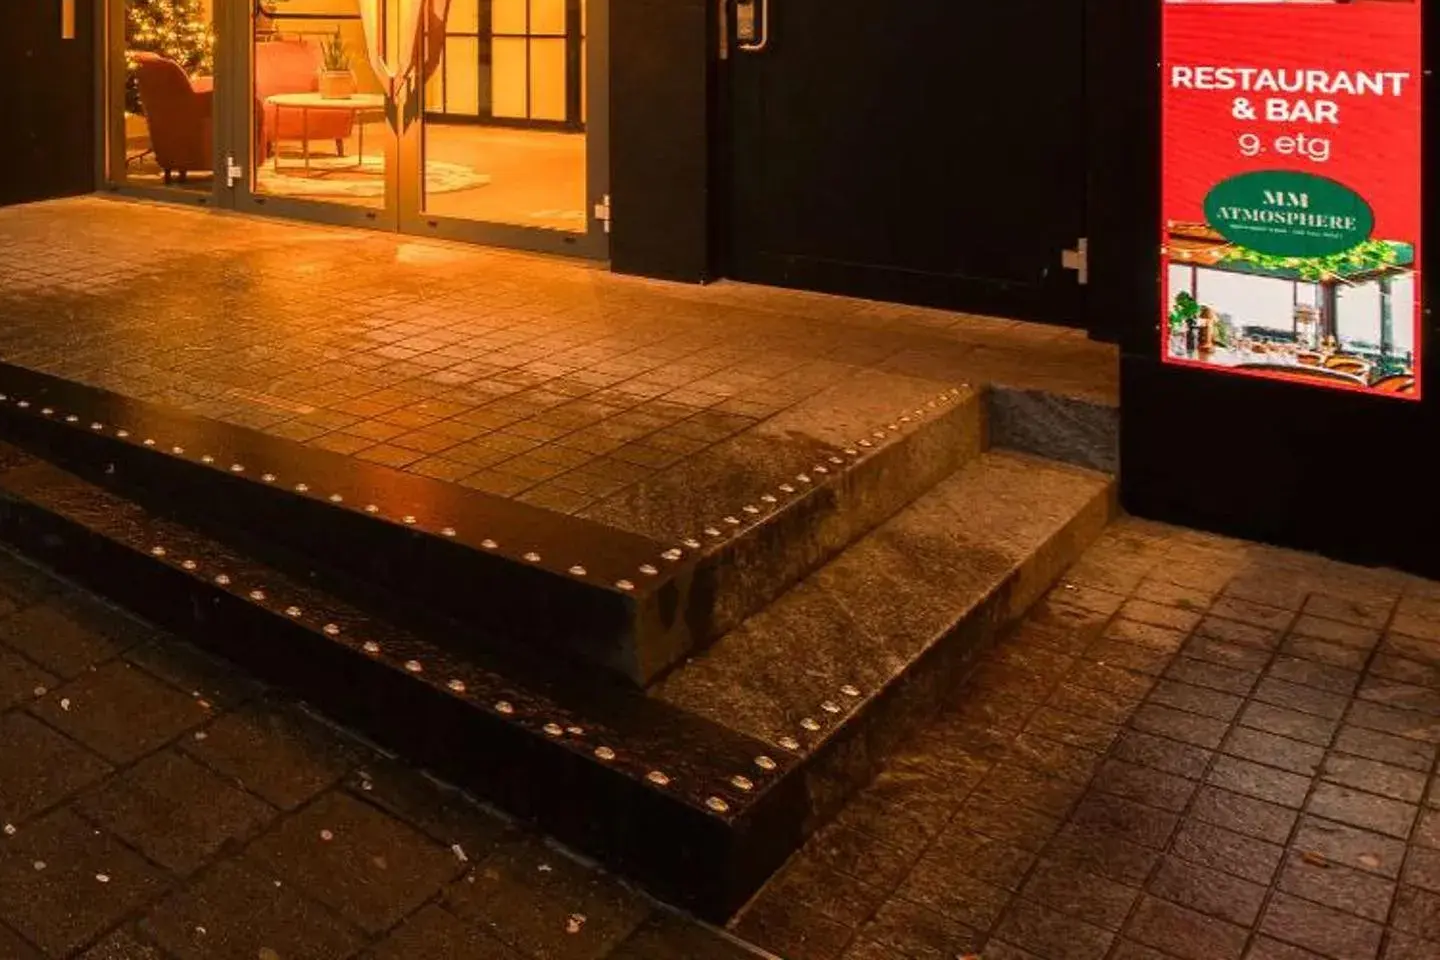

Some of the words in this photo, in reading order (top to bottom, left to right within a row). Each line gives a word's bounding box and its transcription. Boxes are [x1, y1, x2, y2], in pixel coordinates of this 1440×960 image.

[1170, 65, 1410, 96] RESTAURANT
[1231, 97, 1254, 121] &
[1266, 98, 1339, 124] BAR
[1274, 133, 1330, 162] etg
[1262, 189, 1310, 208] MM
[1216, 207, 1357, 230] ATMOSPHERE
